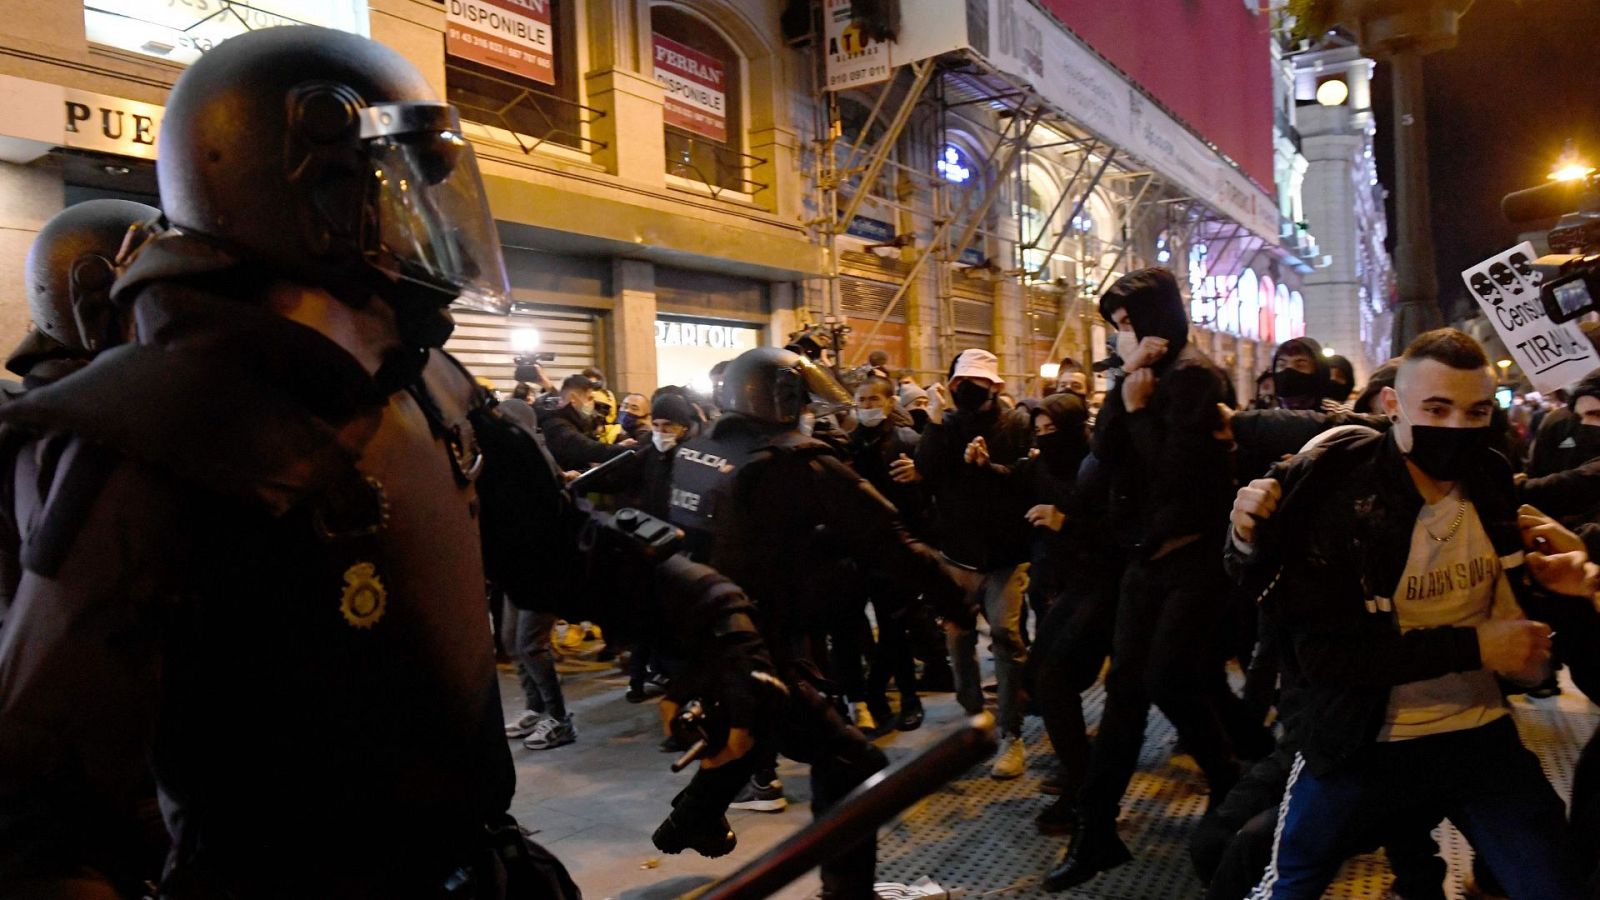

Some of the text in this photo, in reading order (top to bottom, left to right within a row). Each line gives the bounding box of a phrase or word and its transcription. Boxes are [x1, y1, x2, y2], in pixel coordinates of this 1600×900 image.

[451, 0, 546, 45] DISPONIBLE
[655, 44, 722, 84] FERRAN
[64, 100, 156, 146] PUE
